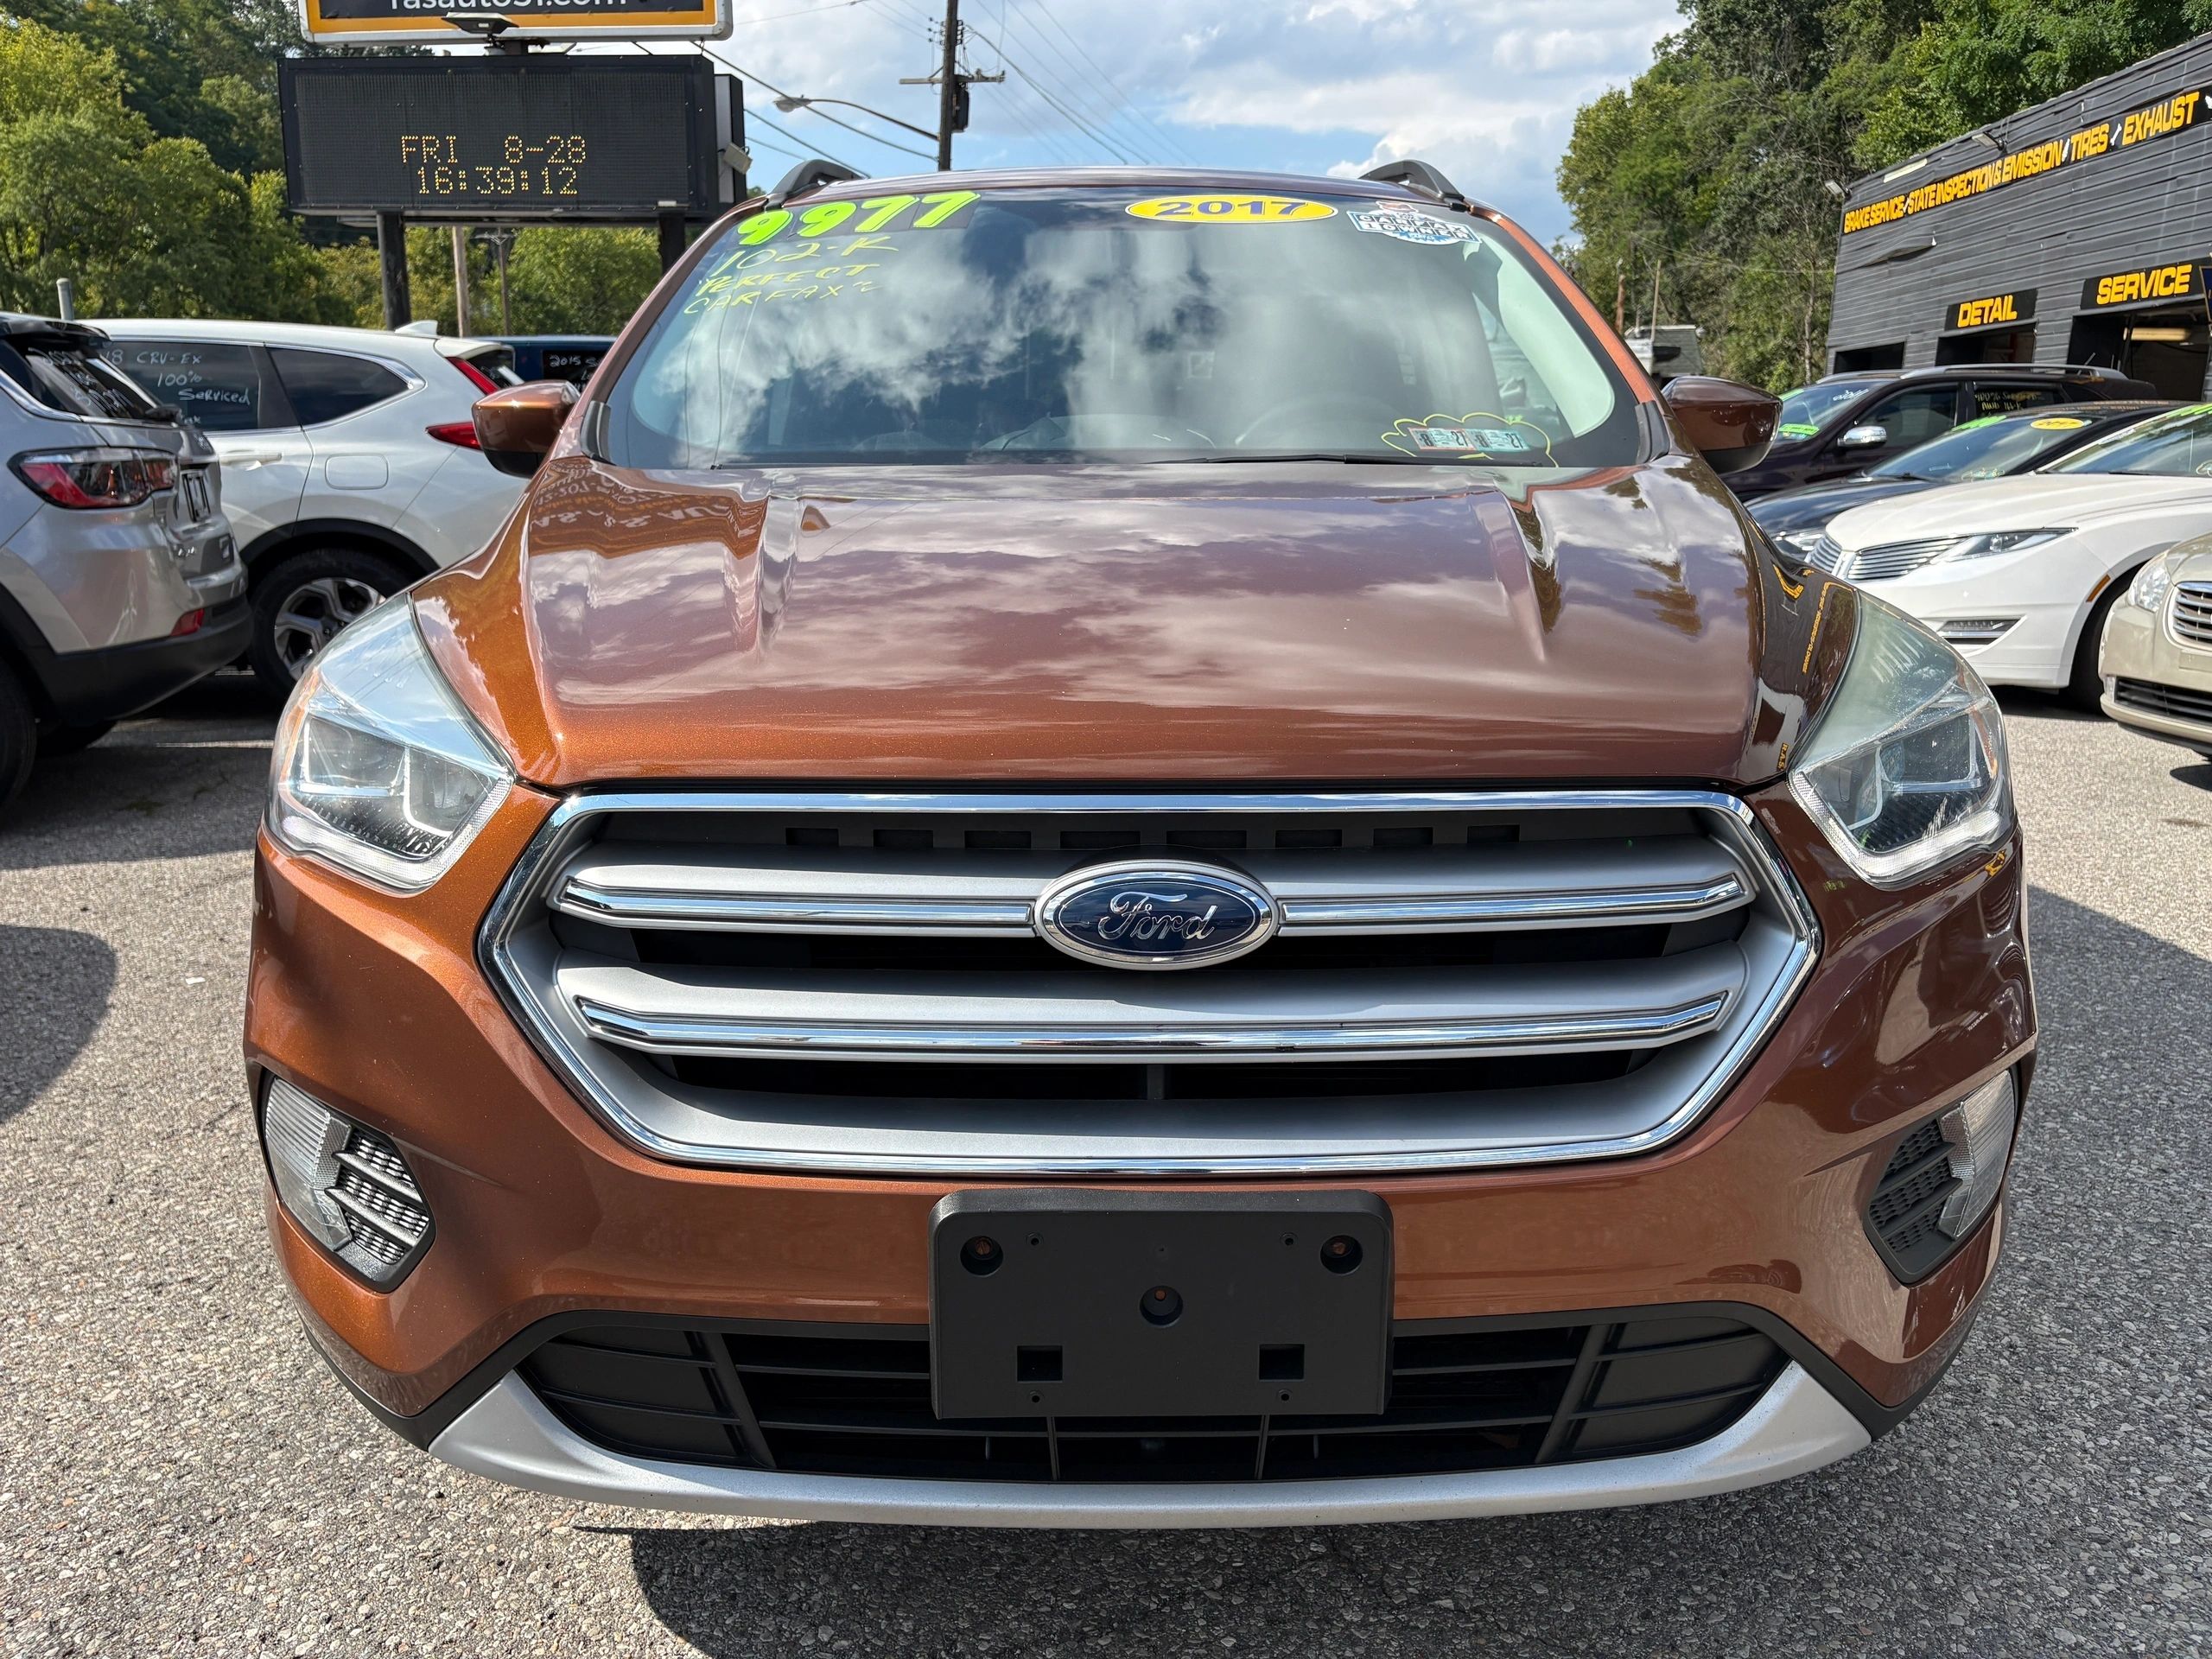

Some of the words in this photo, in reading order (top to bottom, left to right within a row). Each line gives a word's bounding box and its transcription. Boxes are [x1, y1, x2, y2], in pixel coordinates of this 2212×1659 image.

[402, 135, 458, 163] FRI
[505, 135, 587, 163] 8-28
[1843, 206, 1871, 234] BRAKE
[1869, 194, 1905, 227] SERVICE
[1908, 183, 1936, 214] STATE
[1936, 163, 1995, 205] INSPECTION
[2002, 138, 2063, 182] EMISSION
[2070, 123, 2110, 162] TIRES
[2121, 91, 2200, 146] EXHAUST
[418, 166, 578, 194] 16:39:12
[736, 189, 982, 246] 9977
[1154, 200, 1311, 217] 2017
[1359, 214, 1466, 232] CARFAX
[1382, 223, 1471, 239] OWNER
[2095, 264, 2193, 305] SERVICE
[1957, 294, 2018, 328] DETAIL
[549, 354, 582, 367] 2015
[157, 370, 202, 387] 100%
[1450, 430, 1469, 447] 27
[1506, 433, 1523, 448] 27
[1097, 891, 1217, 940] Ford
